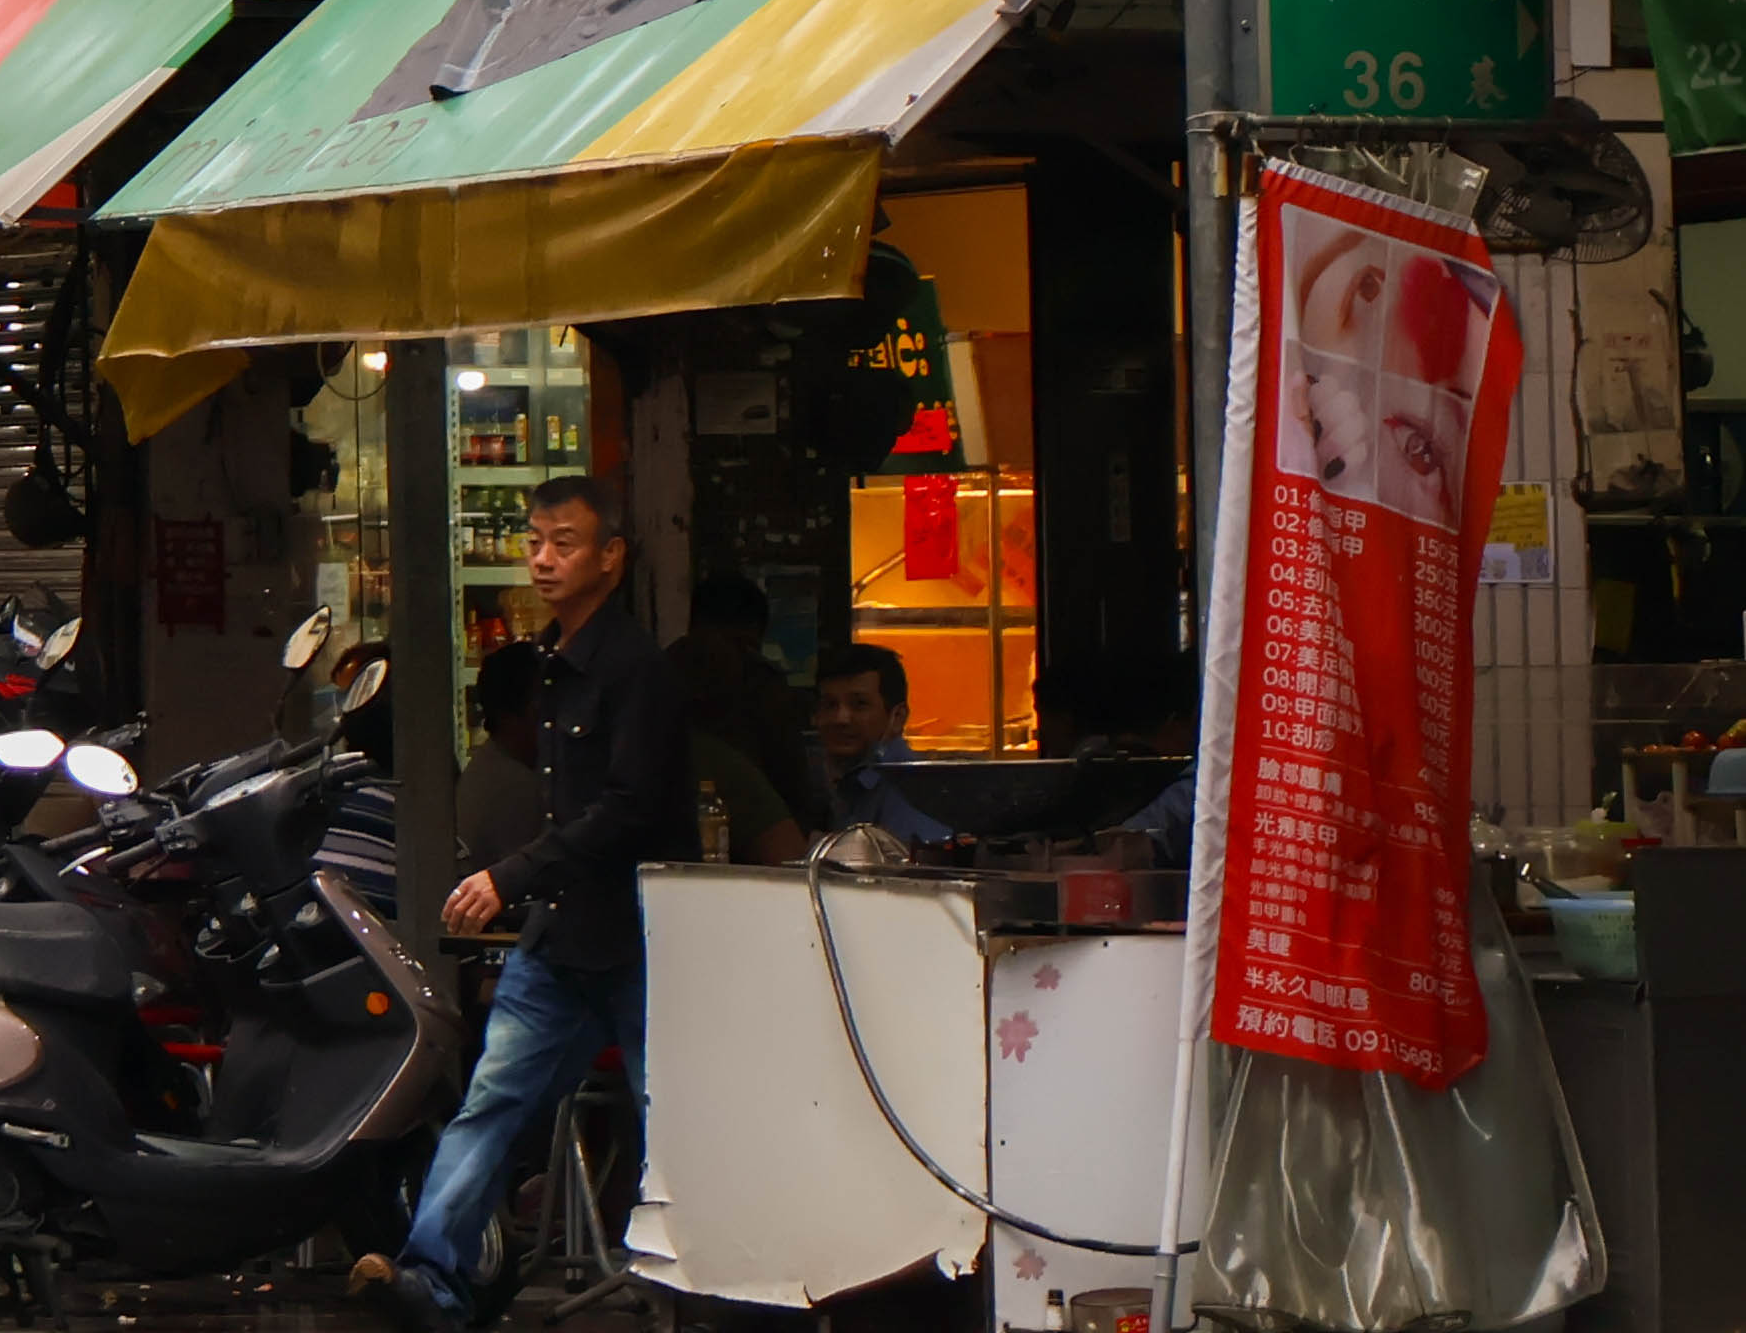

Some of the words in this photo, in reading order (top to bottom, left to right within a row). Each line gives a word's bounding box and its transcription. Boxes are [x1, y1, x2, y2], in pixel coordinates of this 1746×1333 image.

[1342, 50, 1426, 111] 36
[1235, 1004, 1338, 1050] 預約電話
